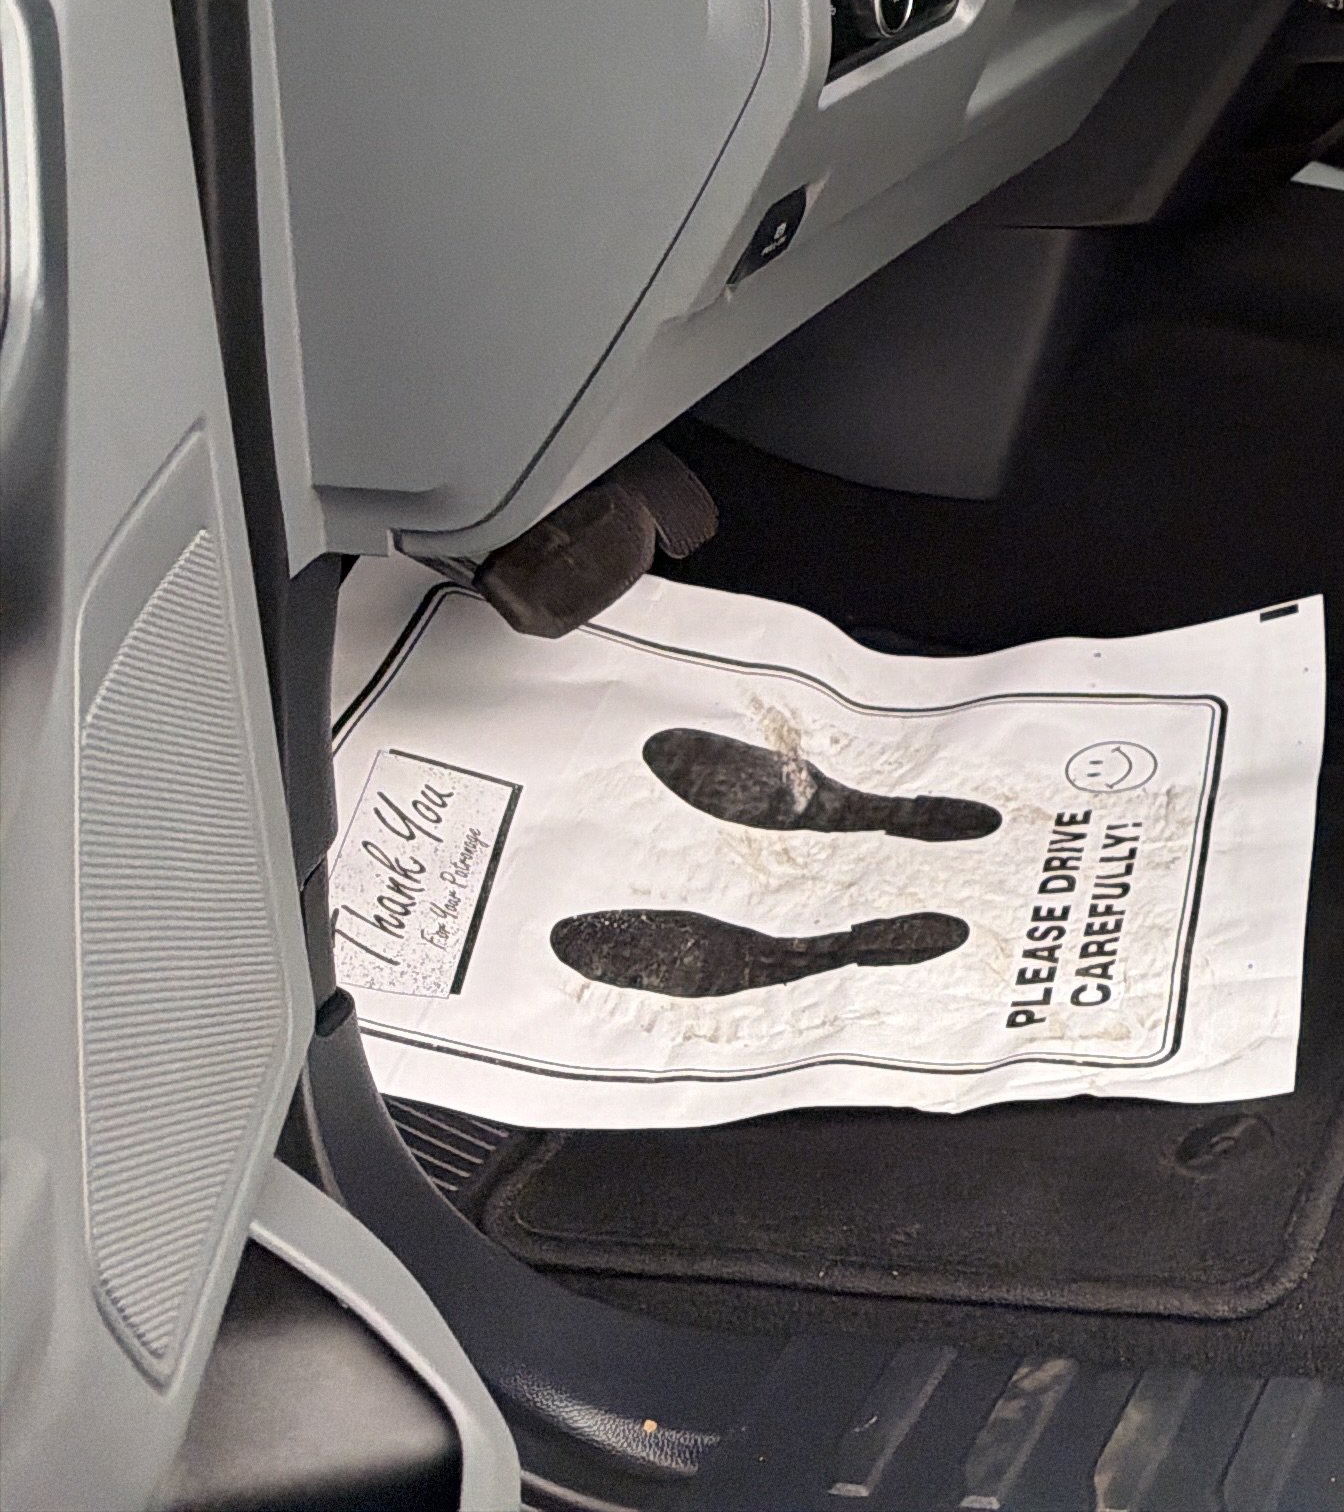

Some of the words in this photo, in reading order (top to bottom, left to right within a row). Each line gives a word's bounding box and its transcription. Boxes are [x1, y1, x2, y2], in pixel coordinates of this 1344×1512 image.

[373, 783, 455, 844] You
[439, 827, 491, 890] Patronage
[1036, 808, 1093, 895] DRIVE
[331, 840, 427, 966] Thank
[420, 922, 452, 952] For
[428, 889, 463, 921] Your
[1069, 821, 1143, 1007] CAREFULLY!
[1005, 904, 1072, 1029] PLEASE
